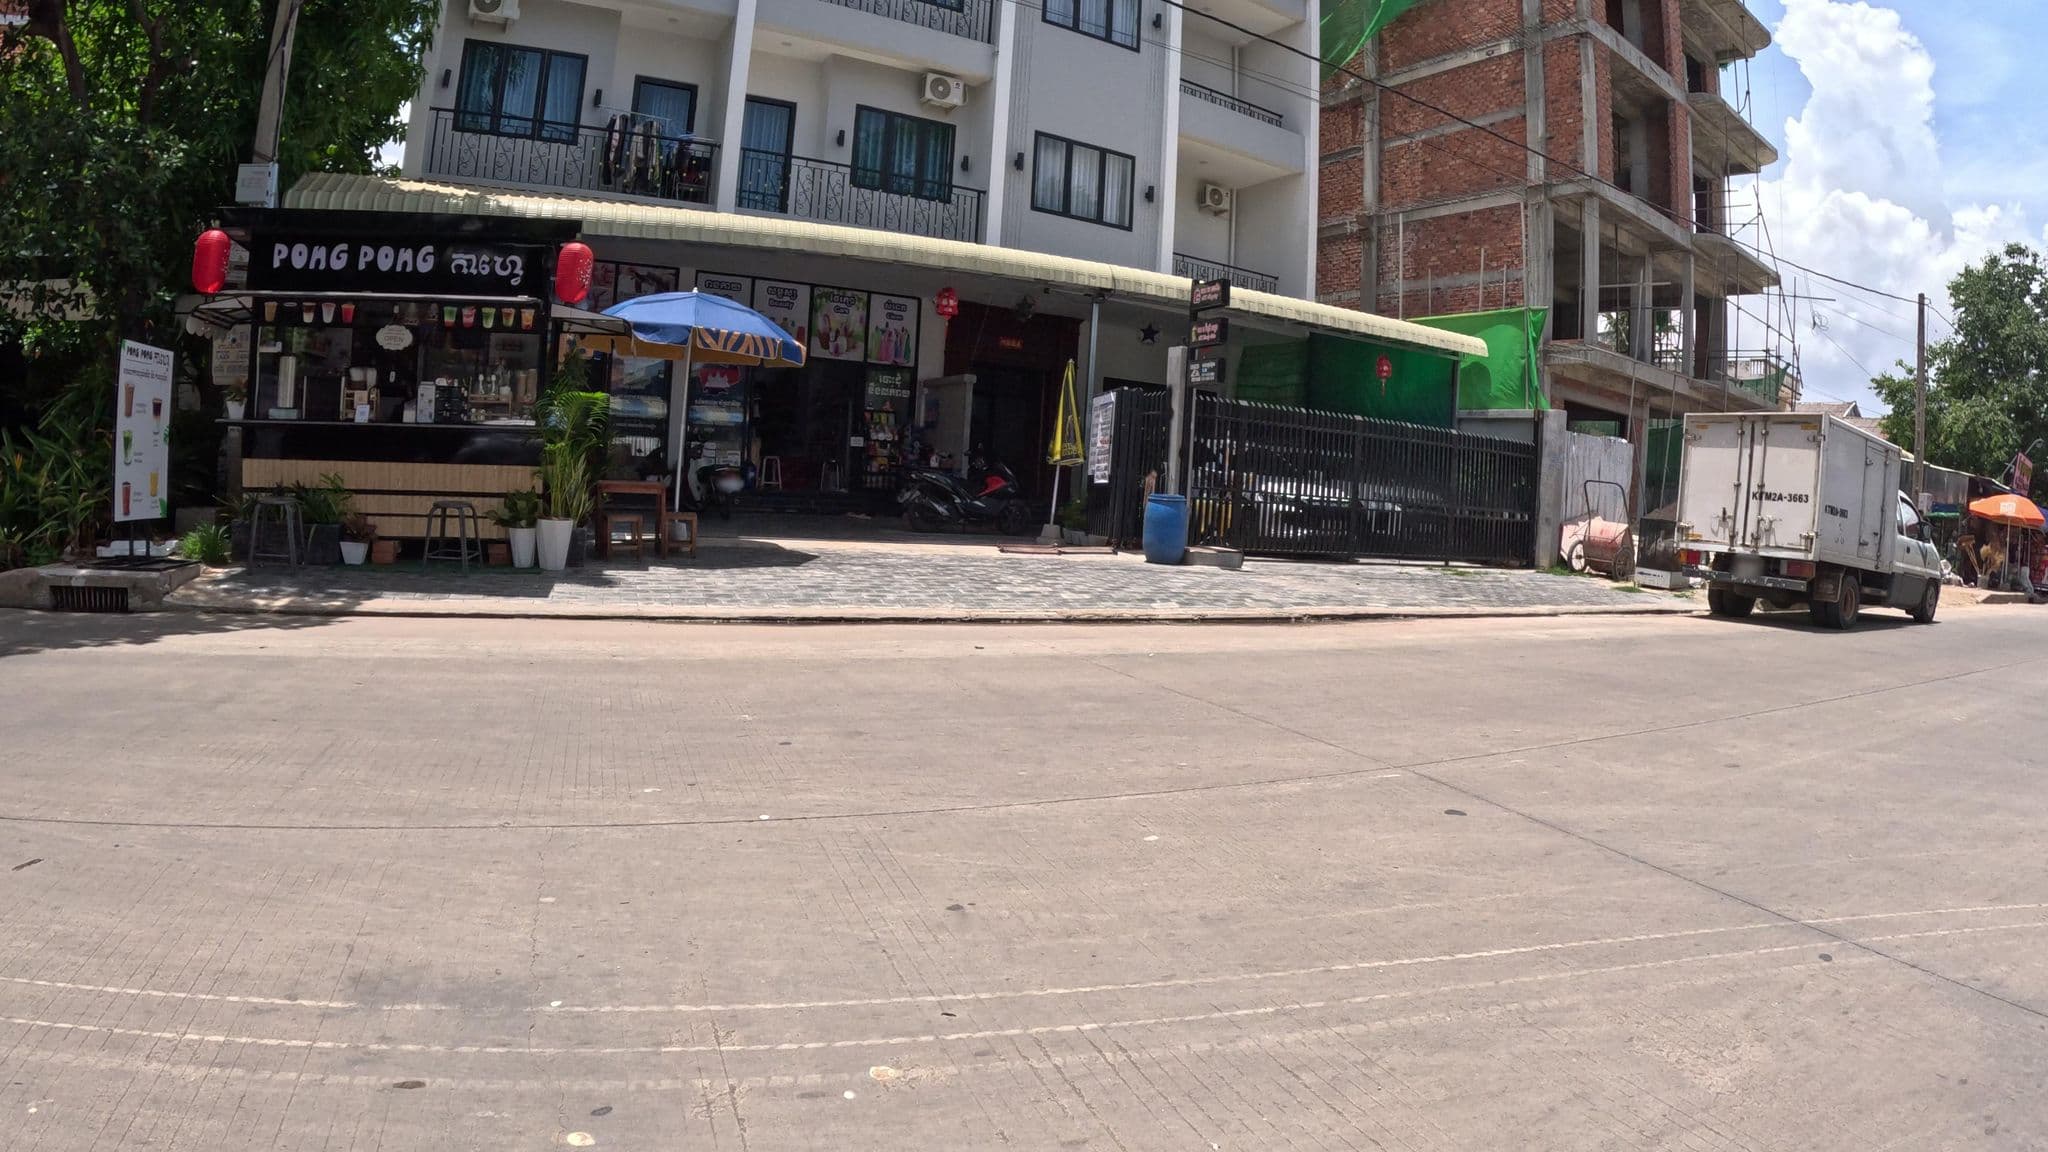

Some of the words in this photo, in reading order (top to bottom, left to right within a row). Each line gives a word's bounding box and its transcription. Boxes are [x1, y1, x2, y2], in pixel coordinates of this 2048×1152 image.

[272, 243, 349, 271] PONG
[357, 245, 435, 273] PONG
[450, 252, 524, 286] កាហ្វេ
[768, 298, 794, 310] Beauty
[384, 335, 404, 343] OPEN
